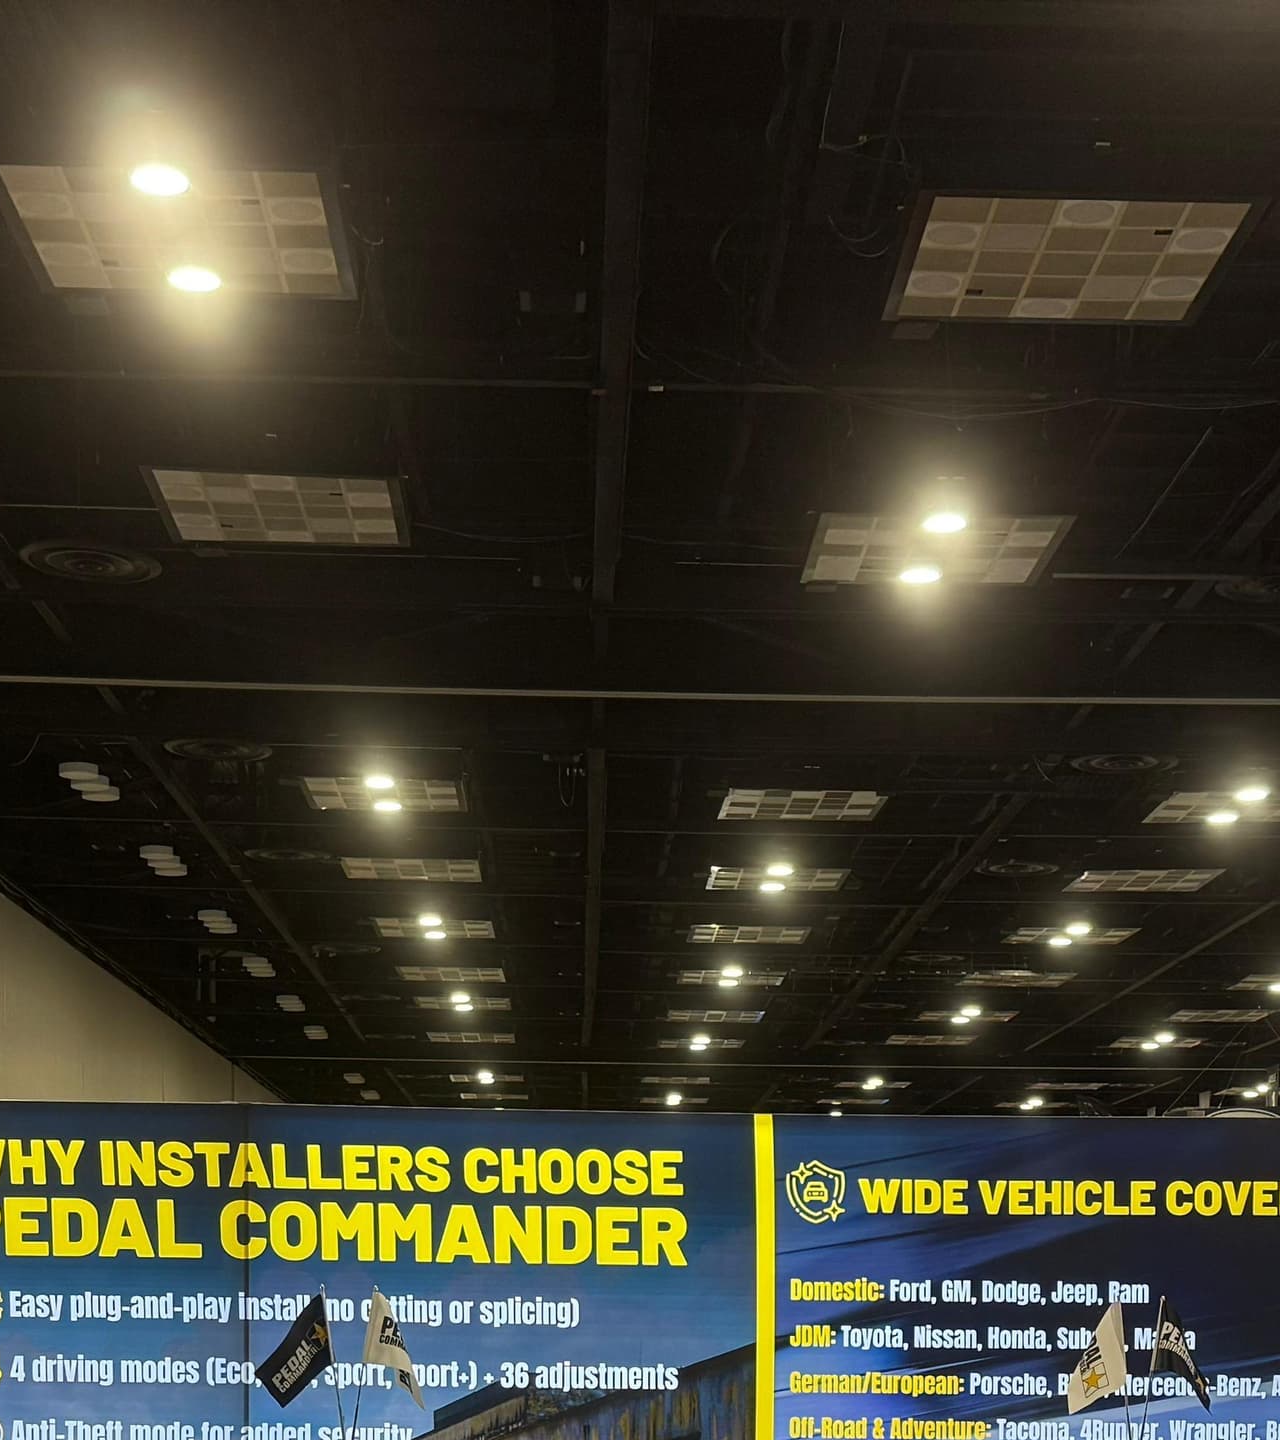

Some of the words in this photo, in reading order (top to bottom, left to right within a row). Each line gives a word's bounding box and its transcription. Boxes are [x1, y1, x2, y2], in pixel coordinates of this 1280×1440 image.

[99, 1140, 451, 1194] INSTALLERS
[463, 1148, 684, 1197] CHOOSE
[858, 1178, 969, 1216] WIDE
[978, 1180, 1156, 1217] VEHICLE
[220, 1199, 688, 1267] COMMANDER
[8, 1290, 62, 1322] Easy
[70, 1291, 232, 1323] plug-and-play
[480, 1296, 580, 1329] splicing)
[789, 1277, 885, 1303] Domestic:
[889, 1278, 937, 1305] Ford,
[942, 1280, 977, 1306] GM,
[982, 1279, 1046, 1306] Dodge,
[1108, 1280, 1150, 1304] Ram
[789, 1325, 836, 1349] JDM:
[841, 1325, 909, 1351] Toyota,
[987, 1325, 1051, 1352] Honda,
[10, 1356, 25, 1383] 4
[32, 1355, 115, 1387] driving
[500, 1364, 529, 1389] 36
[535, 1362, 679, 1393] adjustments
[272, 1338, 313, 1388] PEDAL
[789, 1371, 965, 1397] German/European:
[789, 1416, 868, 1440] Off-Road
